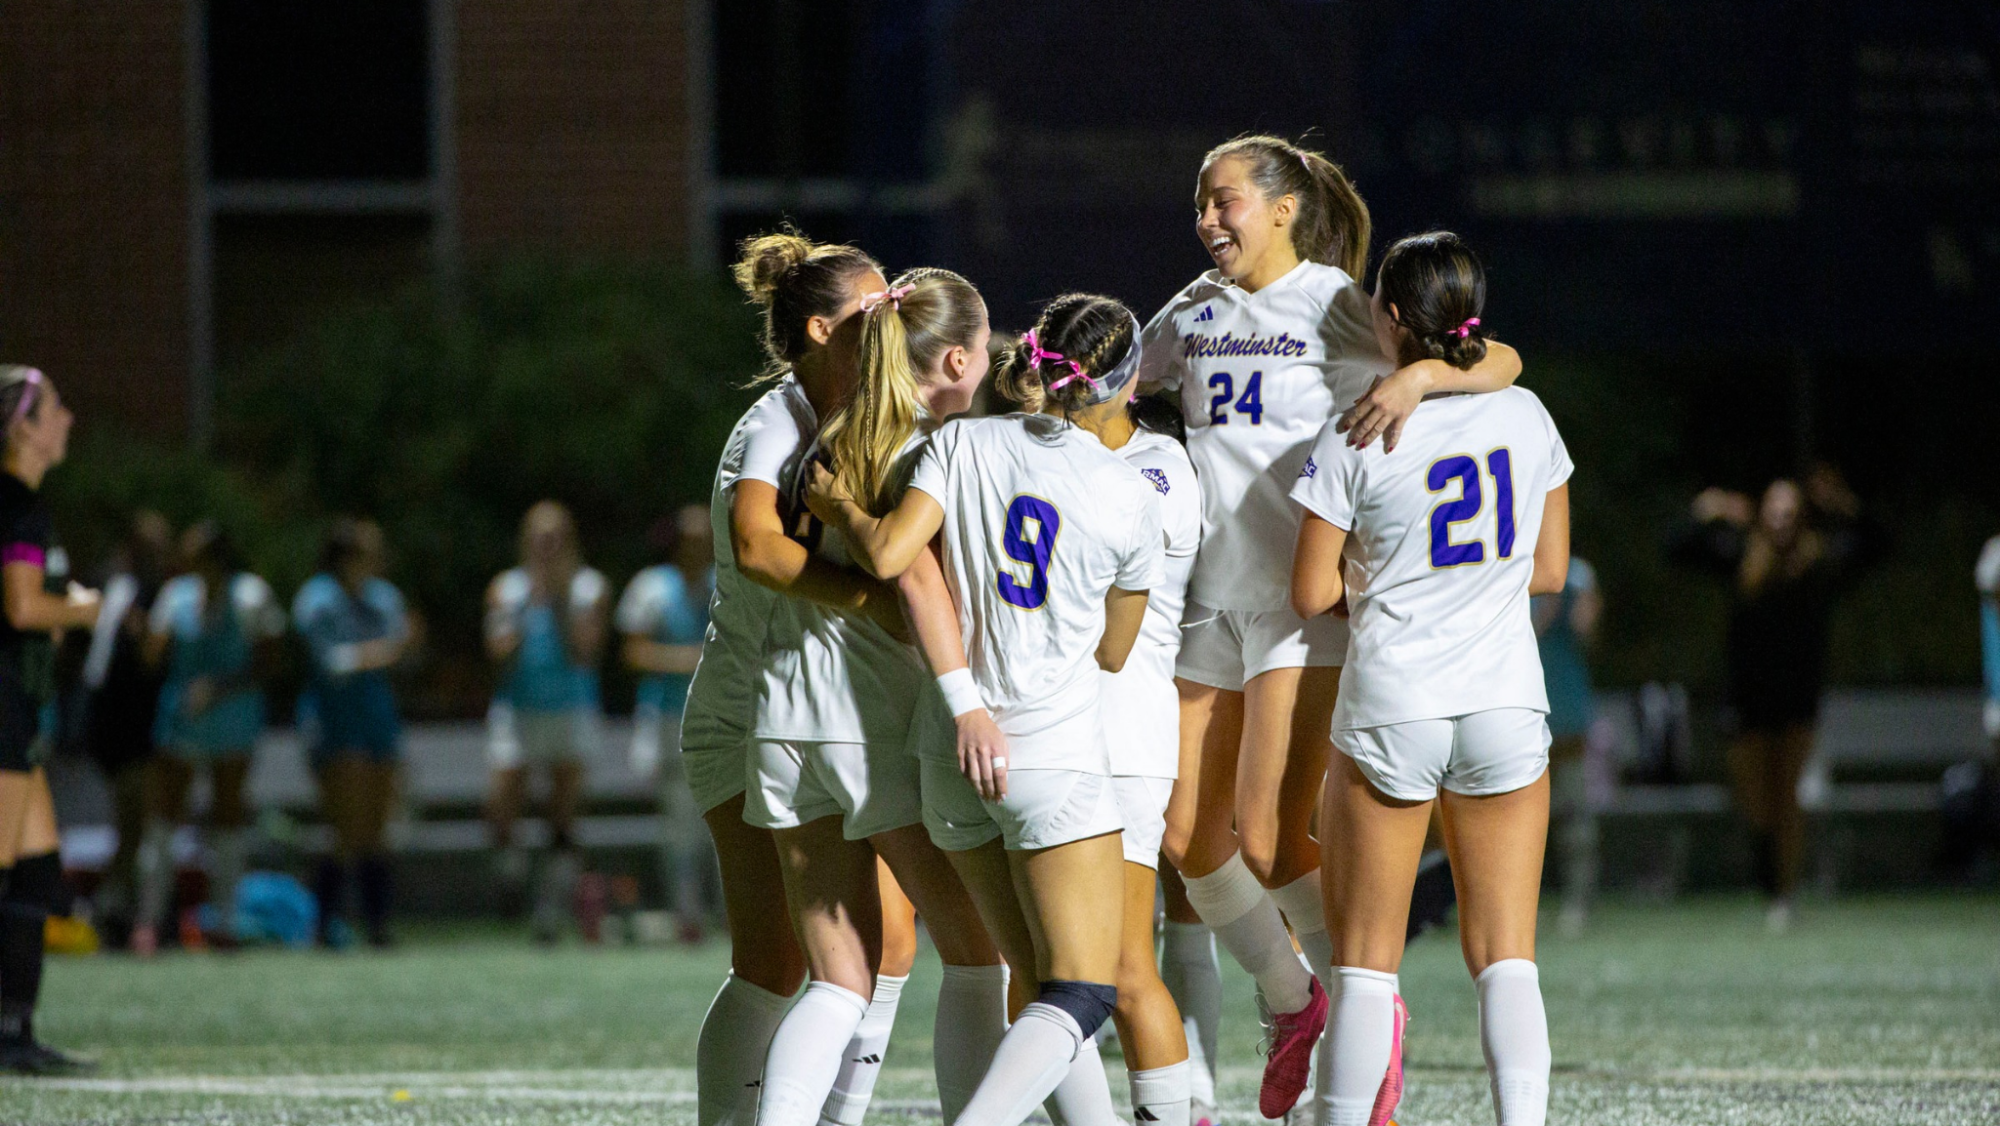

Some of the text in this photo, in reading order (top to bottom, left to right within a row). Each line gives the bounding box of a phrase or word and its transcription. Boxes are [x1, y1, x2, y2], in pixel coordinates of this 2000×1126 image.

[1184, 331, 1308, 359] Westminster
[1207, 370, 1264, 427] 24
[1142, 469, 1170, 494] RMAC
[1423, 445, 1518, 571] 21
[994, 491, 1064, 613] 9
